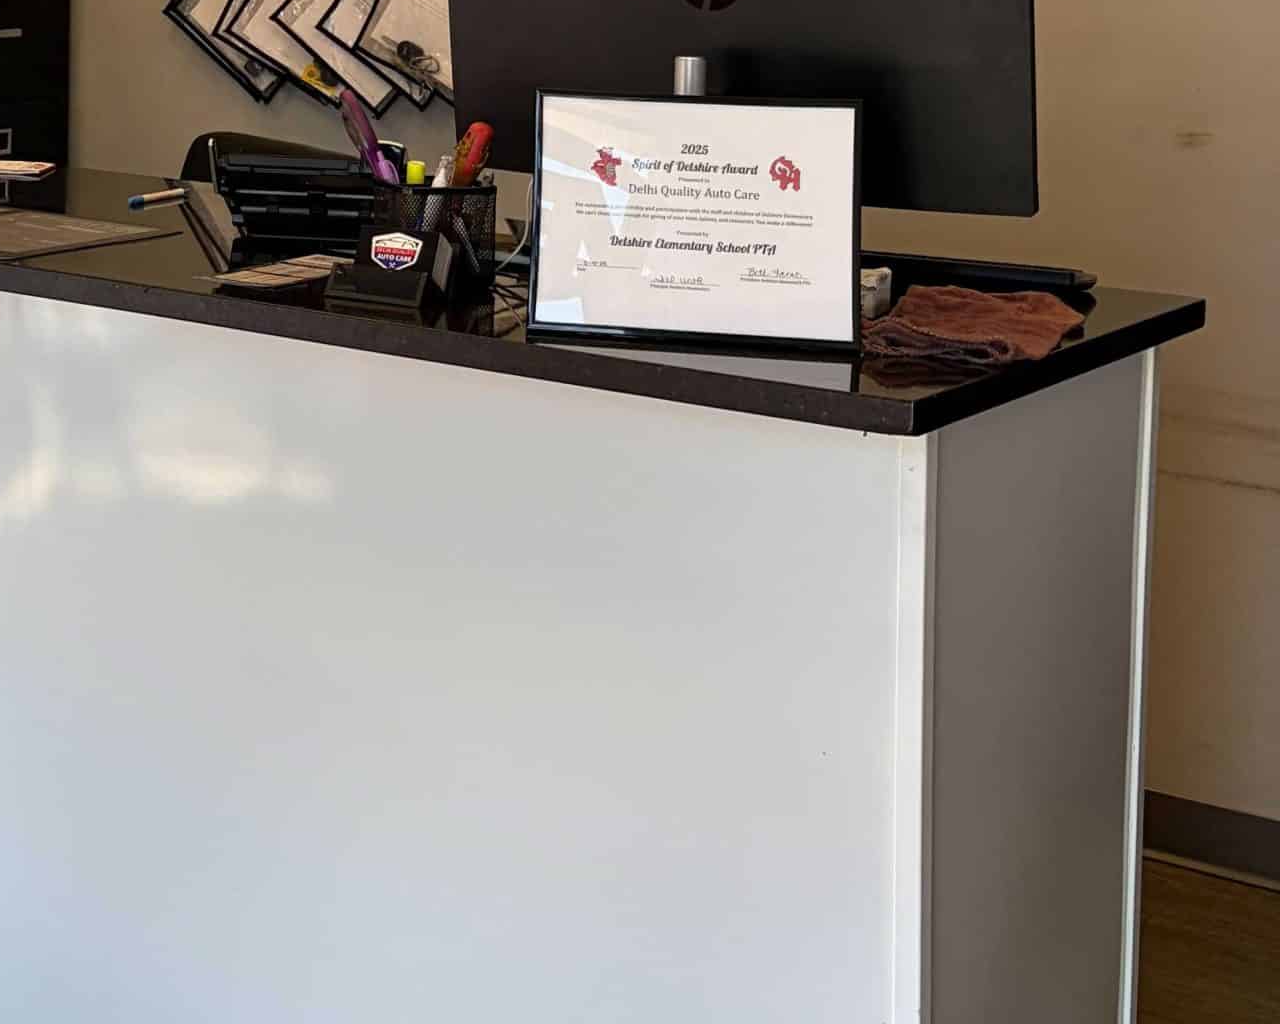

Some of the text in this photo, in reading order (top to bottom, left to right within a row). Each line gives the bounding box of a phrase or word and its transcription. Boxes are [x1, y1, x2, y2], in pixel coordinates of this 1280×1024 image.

[680, 144, 709, 156] 2025
[632, 158, 661, 172] Spirit
[662, 159, 676, 174] of
[721, 161, 759, 176] Award
[628, 183, 761, 201] Delhi Quality Auto Care
[654, 237, 714, 256] Elementary
[715, 241, 752, 255] School
[377, 253, 395, 261] AUTO
